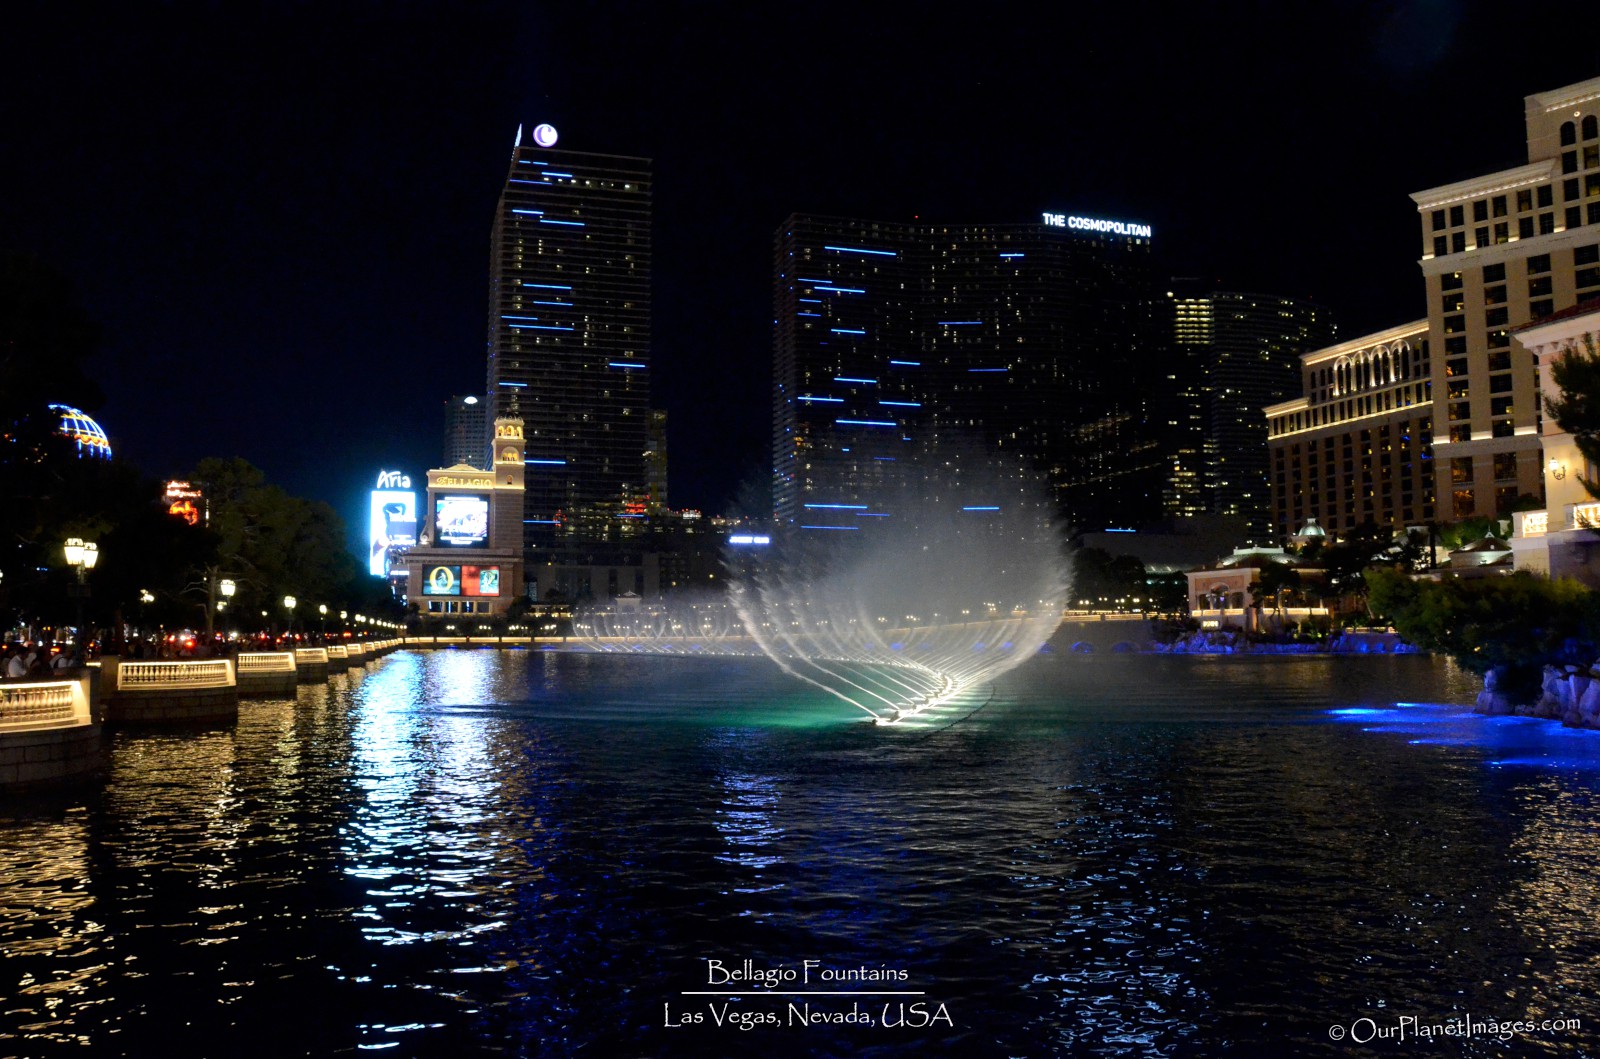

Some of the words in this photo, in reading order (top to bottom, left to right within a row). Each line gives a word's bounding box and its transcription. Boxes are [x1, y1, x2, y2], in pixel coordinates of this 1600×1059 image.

[1042, 212, 1066, 227] THE
[1067, 215, 1152, 238] COSMOPOLITAN
[376, 470, 412, 489] Aria
[436, 476, 493, 488] BELLAGIO
[429, 565, 455, 591] O
